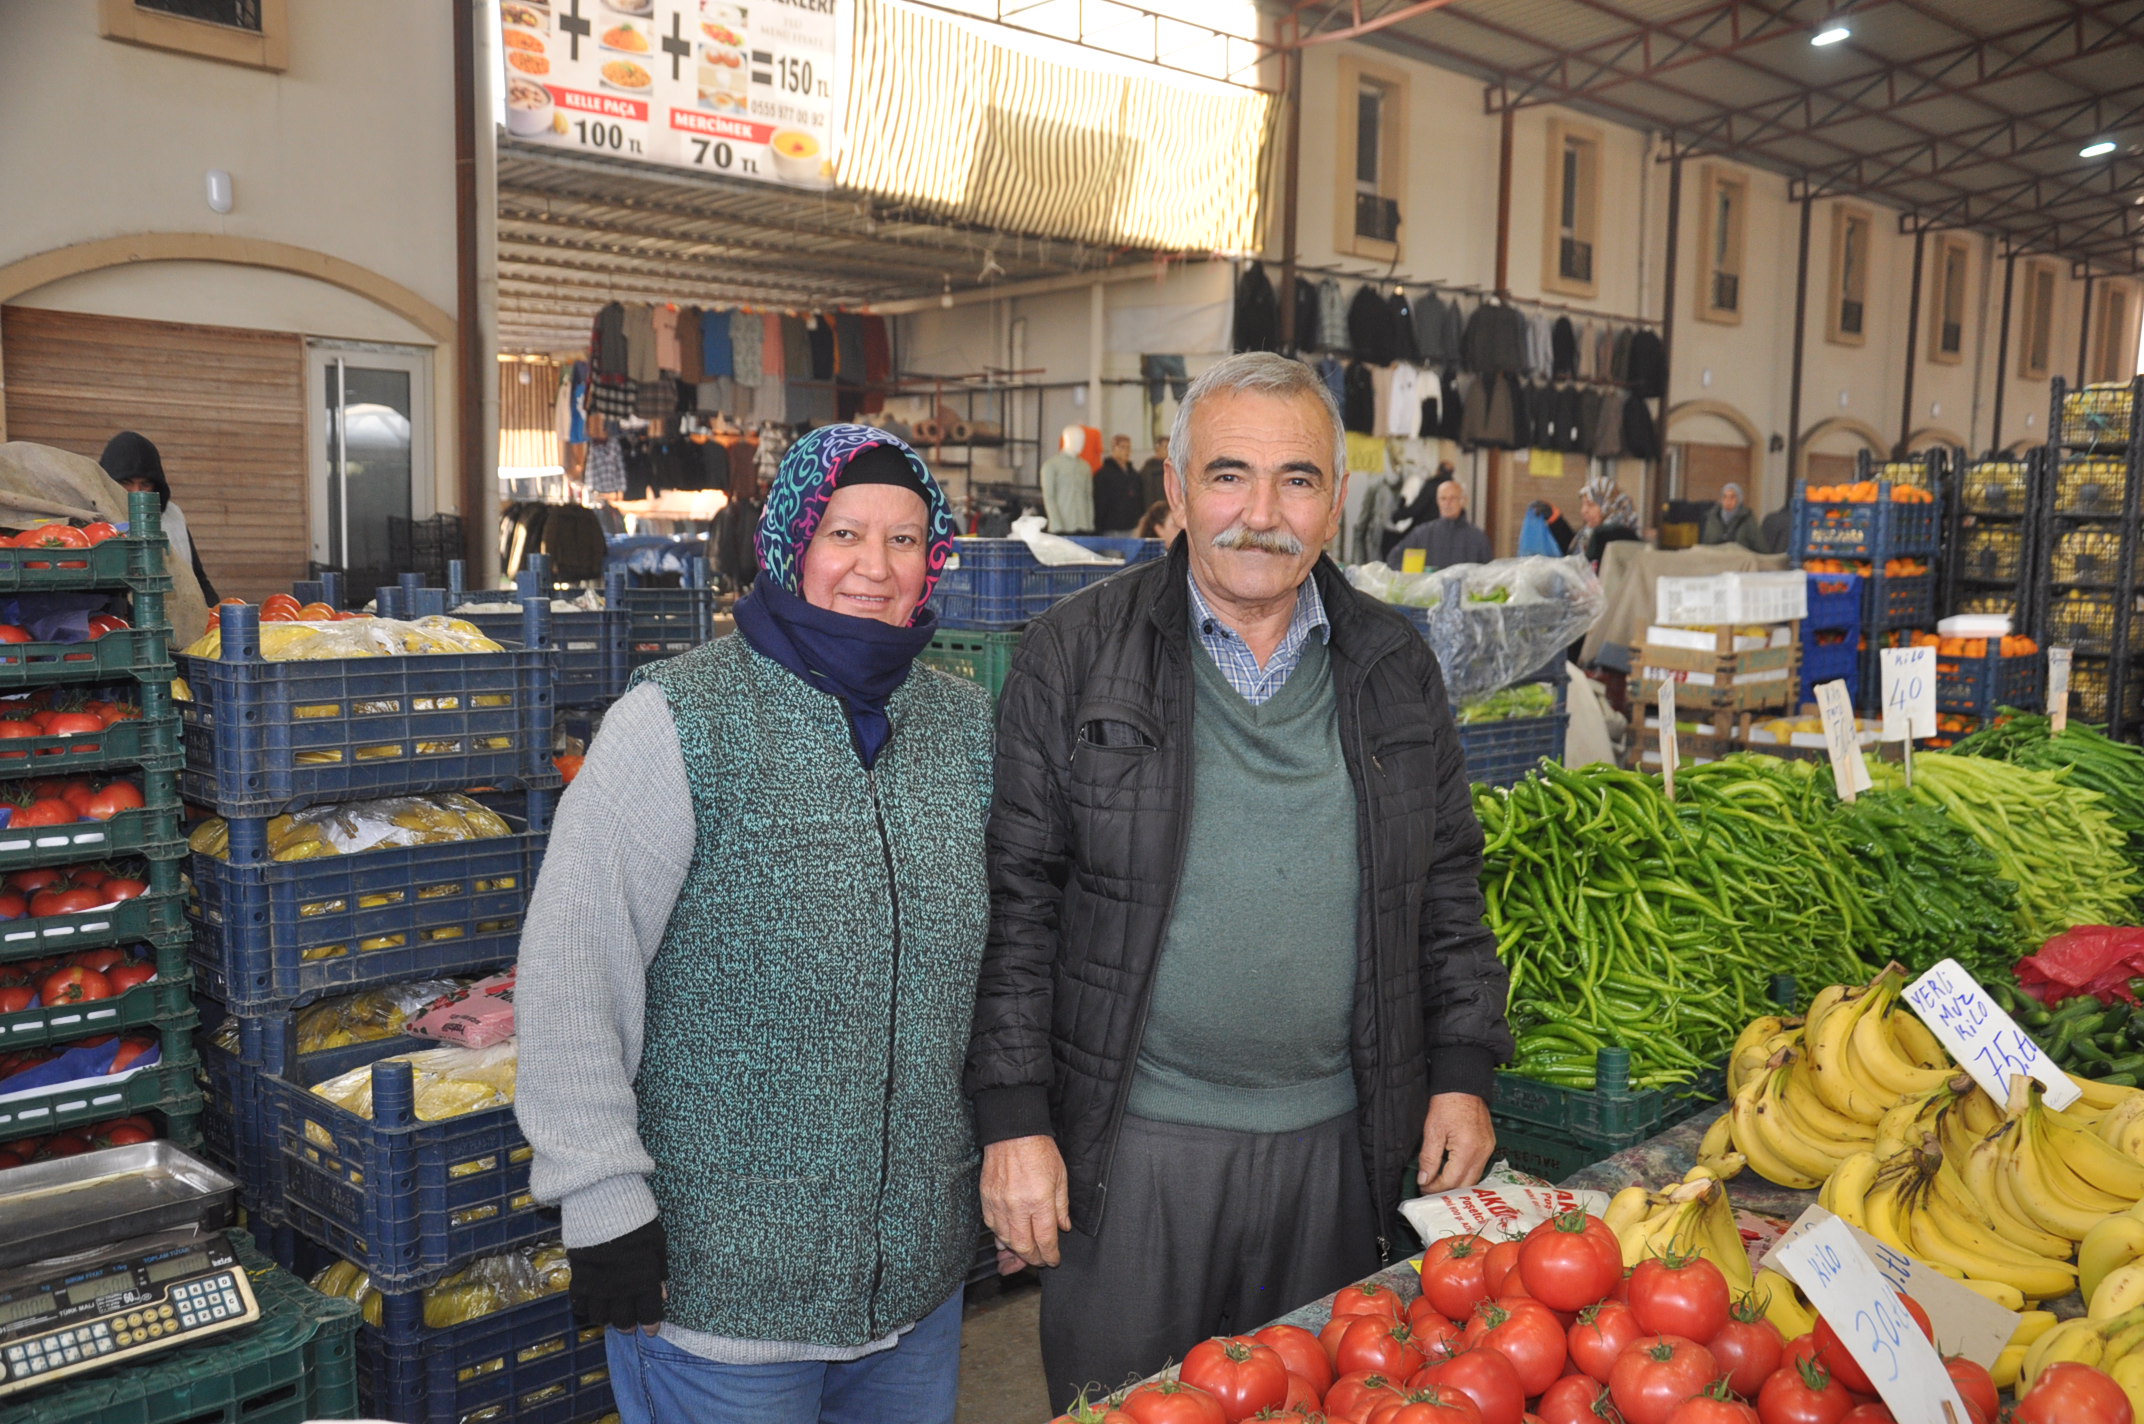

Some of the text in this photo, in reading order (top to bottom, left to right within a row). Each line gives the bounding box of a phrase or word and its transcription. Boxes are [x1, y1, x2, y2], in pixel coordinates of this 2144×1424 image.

[778, 55, 829, 98] 150 TL
[565, 91, 637, 118] KELLE PAÇA
[574, 119, 642, 154] 100 TL
[674, 111, 753, 140] MERCİMEK
[690, 138, 759, 174] 70 TL
[1888, 676, 1923, 710] 40
